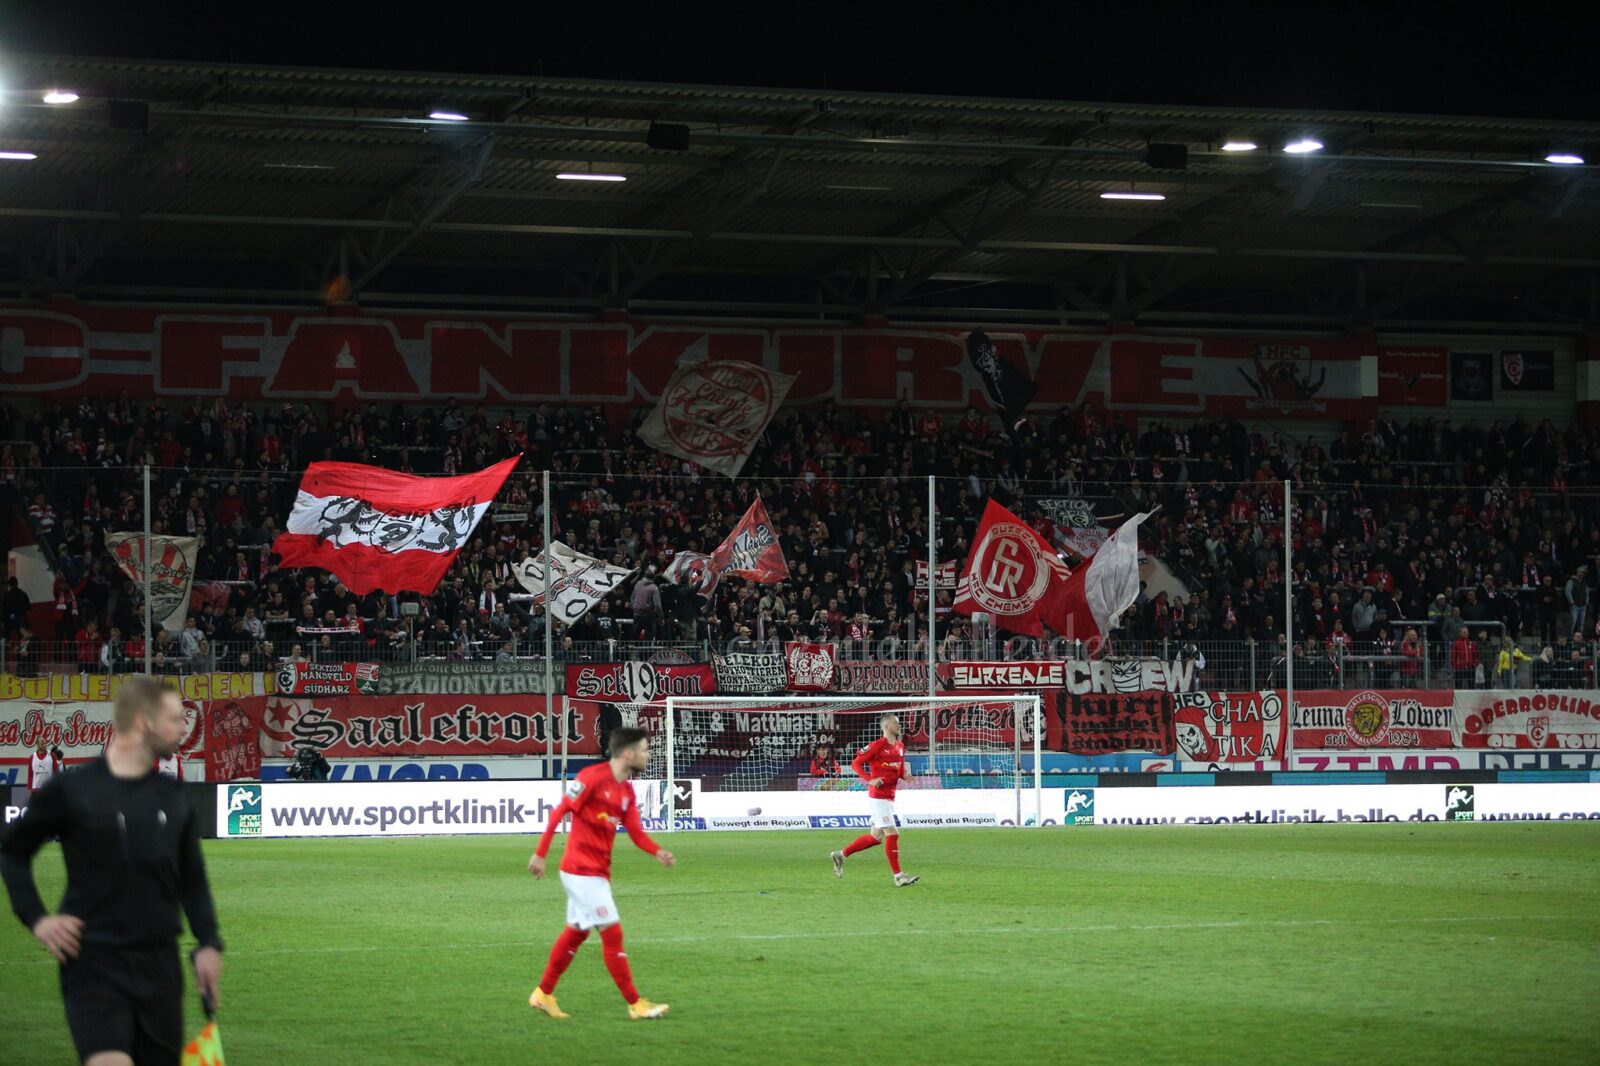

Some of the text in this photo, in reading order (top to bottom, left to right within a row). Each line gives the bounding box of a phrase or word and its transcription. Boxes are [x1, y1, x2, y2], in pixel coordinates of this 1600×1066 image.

[309, 663, 343, 672] SEKTION
[300, 672, 353, 681] MANSFELD
[953, 665, 1063, 686] SURREALE
[304, 682, 350, 694] SÜDHARZ
[1292, 699, 1452, 728] Leuna Löwen
[290, 702, 584, 751] Saalefront
[735, 712, 813, 733] Matthias
[1325, 732, 1348, 746] seit
[642, 820, 696, 830] UNON
[713, 818, 806, 828] bewegt die Region
[819, 817, 841, 828] PS
[906, 816, 943, 826] bewegt
[945, 816, 961, 825] die
[962, 815, 996, 825] Region
